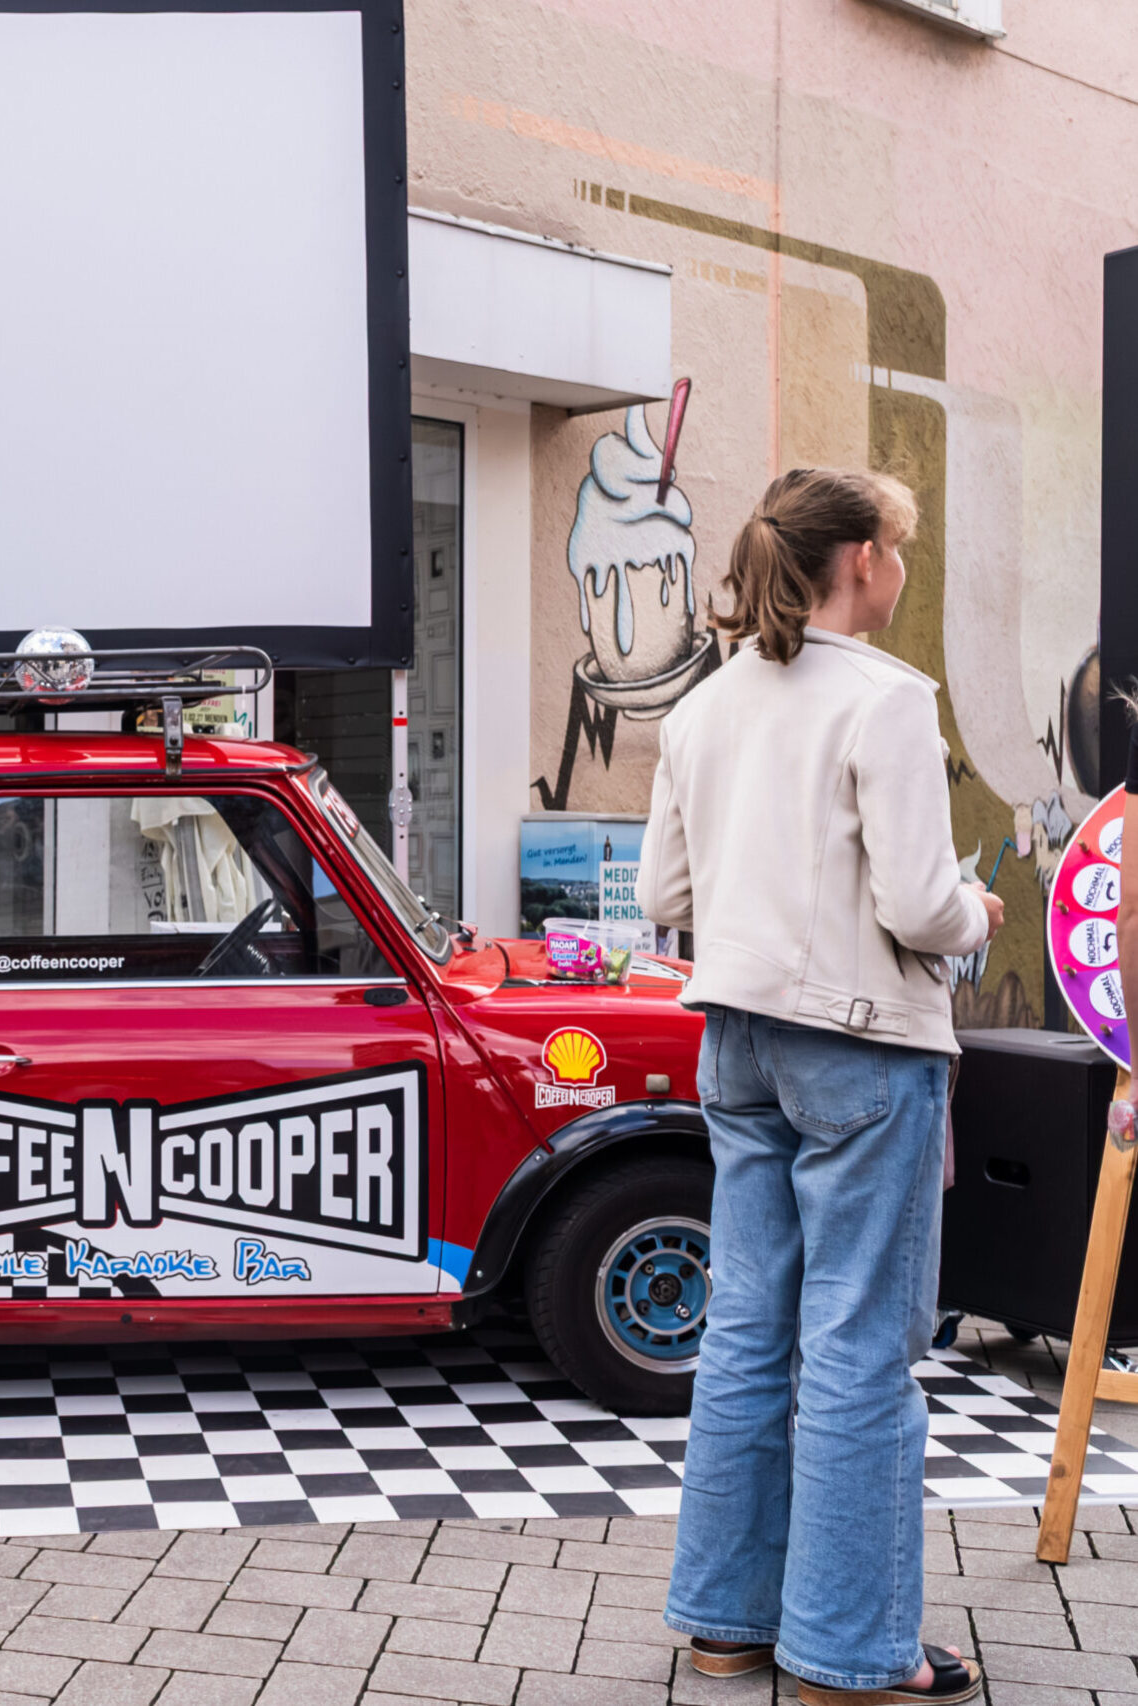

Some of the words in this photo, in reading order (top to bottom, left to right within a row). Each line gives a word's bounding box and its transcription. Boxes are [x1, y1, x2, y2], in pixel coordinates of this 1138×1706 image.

[544, 844, 576, 857] versorgt
[1084, 867, 1105, 907] NOCHMAL
[603, 904, 648, 920] MENDE
[1086, 922, 1097, 964] NOCHMAL
[1101, 975, 1124, 1017] NOCHMAL
[569, 1089, 580, 1106] N
[580, 1089, 612, 1107] COOPER
[83, 1107, 152, 1220] N
[161, 1103, 393, 1226] COOPER
